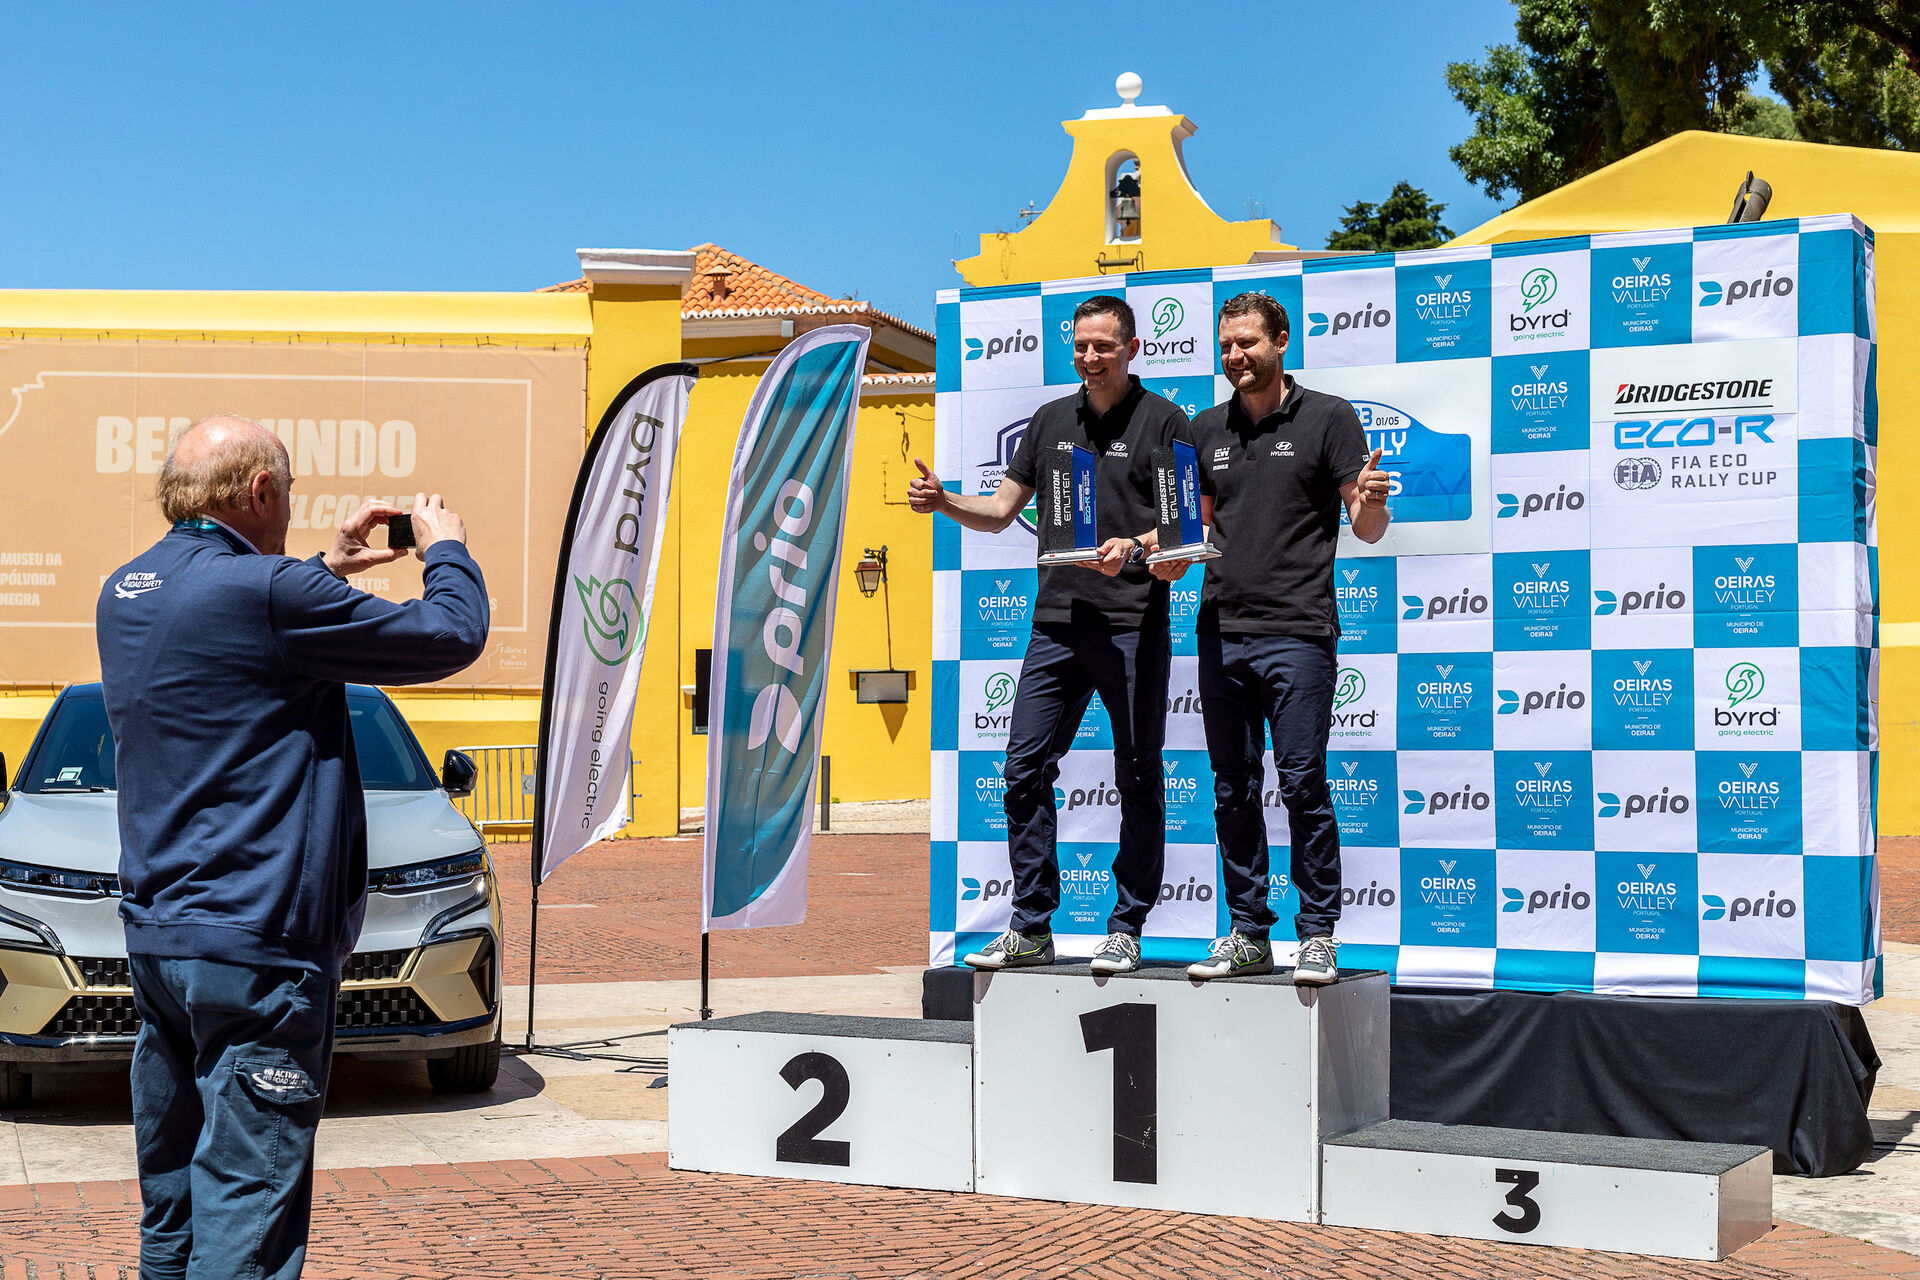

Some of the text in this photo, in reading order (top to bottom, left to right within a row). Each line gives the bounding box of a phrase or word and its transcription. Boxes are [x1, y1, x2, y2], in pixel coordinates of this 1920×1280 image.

[1612, 274, 1670, 293] OEIRAS
[1726, 270, 1793, 305] prio
[1416, 291, 1470, 311] OEIRAS
[1612, 288, 1671, 303] VALLEY
[1332, 303, 1390, 335] prio
[1416, 304, 1471, 320] VALLEY
[1511, 310, 1567, 333] byrd
[1513, 330, 1565, 342] going electric
[986, 329, 1038, 359] prio
[1144, 337, 1194, 356] byrd
[1432, 340, 1454, 348] OEIRAS
[1146, 356, 1192, 366] going electric
[1512, 382, 1567, 396] OEIRAS
[1615, 380, 1772, 404] BRIDGESTONE
[1512, 396, 1567, 410] VALLEY
[1376, 417, 1399, 426] 01/05
[1106, 450, 1128, 458] HYUNDAI
[1214, 447, 1230, 457] EW
[1672, 454, 1746, 469] FIA ECO
[614, 410, 664, 556] byrd
[1672, 472, 1776, 488] RALLY CUP
[1053, 469, 1061, 526] BRIDGESTONE
[1063, 472, 1071, 521] ENLITEN
[1158, 467, 1169, 524] BRIDGESTONE
[1168, 469, 1178, 519] ENLITEN
[1522, 484, 1584, 517] prio
[0, 552, 62, 566] MUSEU DA
[132, 572, 157, 580] ACTION
[754, 478, 814, 676] prio
[1715, 576, 1774, 588] OEIRAS
[141, 580, 163, 588] SAFETY
[1514, 581, 1569, 594] OEIRAS
[1170, 591, 1197, 602] RAS
[1337, 587, 1377, 598] EIRAS
[1621, 583, 1685, 615] prio
[1715, 590, 1775, 603] VALLEY
[979, 596, 1027, 608] OEIRAS
[1337, 600, 1378, 612] ALLEY
[1427, 588, 1488, 620] prio
[1513, 595, 1569, 608] VALLEY
[979, 609, 1027, 620] VALLEY
[1418, 682, 1472, 694] OEIRAS
[1614, 679, 1672, 691] OEIRAS
[1417, 694, 1472, 710] VALLEY
[1523, 683, 1585, 714] prio
[1614, 694, 1672, 706] VALLEY
[976, 713, 1011, 729] byr
[1715, 708, 1776, 726] byrd
[1718, 729, 1741, 737] going
[582, 681, 610, 830] going electric
[976, 778, 1006, 788] OEIR
[1165, 778, 1196, 789] IRAS
[1516, 780, 1572, 792] OEIRAS
[1719, 782, 1779, 794] OEIRAS
[976, 790, 1004, 801] VALL
[1068, 782, 1121, 810] prio
[1165, 791, 1196, 803] LLEY
[1429, 784, 1490, 814] prio
[1516, 794, 1572, 806] VALLEY
[1624, 787, 1689, 818] prio
[1719, 796, 1779, 808] VALLEY
[1060, 870, 1109, 881] OEIRAS
[983, 880, 1013, 901] pr
[1060, 883, 1110, 895] VALLEY
[1156, 876, 1212, 905] prio
[1421, 878, 1476, 890] OEIRAS
[1618, 882, 1676, 895] OEIRAS
[1421, 891, 1476, 904] VALLEY
[1528, 883, 1590, 913] prio
[1618, 896, 1676, 909] VALLEY
[1730, 890, 1796, 921] prio
[275, 1070, 300, 1079] ACTION
[1080, 1001, 1157, 1185] 1
[776, 1052, 850, 1166] 2
[1492, 1168, 1540, 1233] 3
